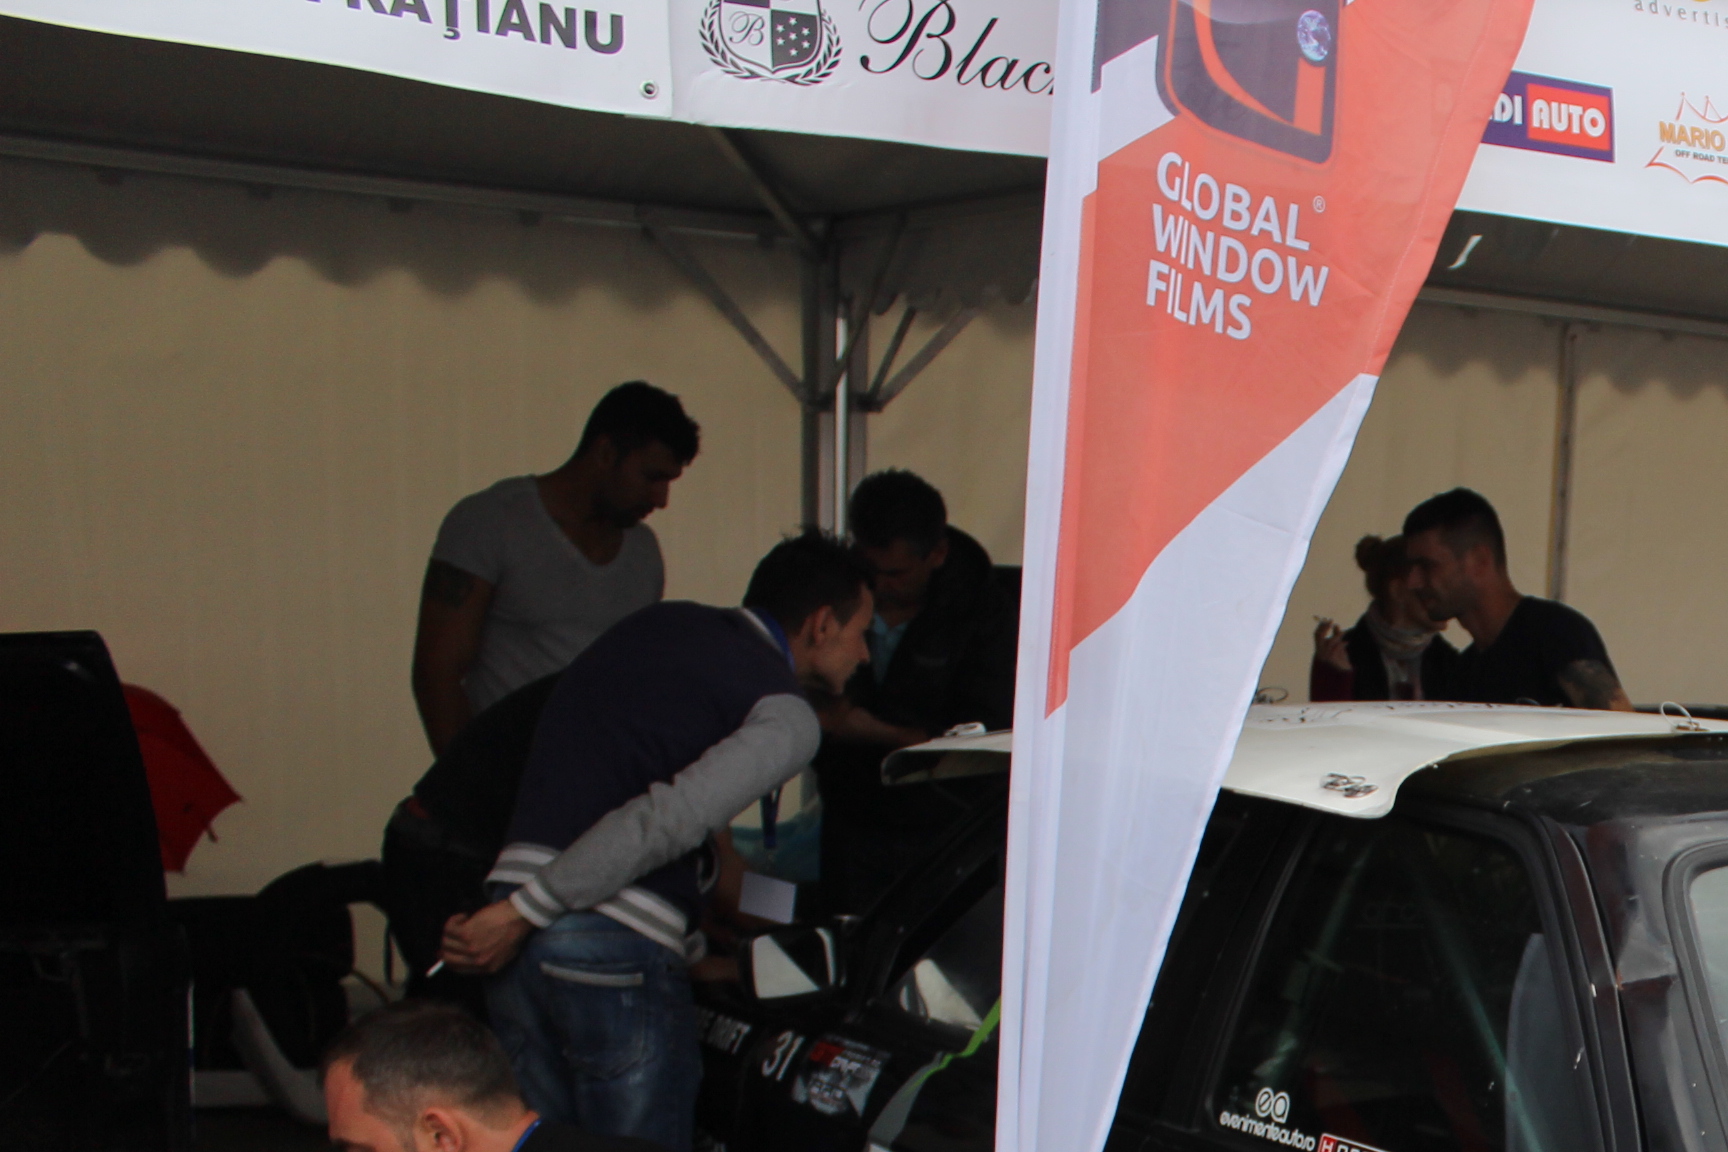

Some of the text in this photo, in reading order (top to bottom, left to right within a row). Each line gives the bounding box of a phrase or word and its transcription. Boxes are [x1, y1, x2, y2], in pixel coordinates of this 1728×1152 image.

[860, 0, 1054, 94] Blac
[1532, 98, 1606, 137] AUTO
[1659, 120, 1726, 151] MARIO
[1674, 148, 1691, 159] OFF
[1692, 151, 1716, 163] ROAD
[1157, 151, 1311, 250] GLOBAL
[1153, 203, 1329, 307] WINDOW
[1146, 259, 1252, 340] FILMS
[761, 1030, 805, 1082] 31
